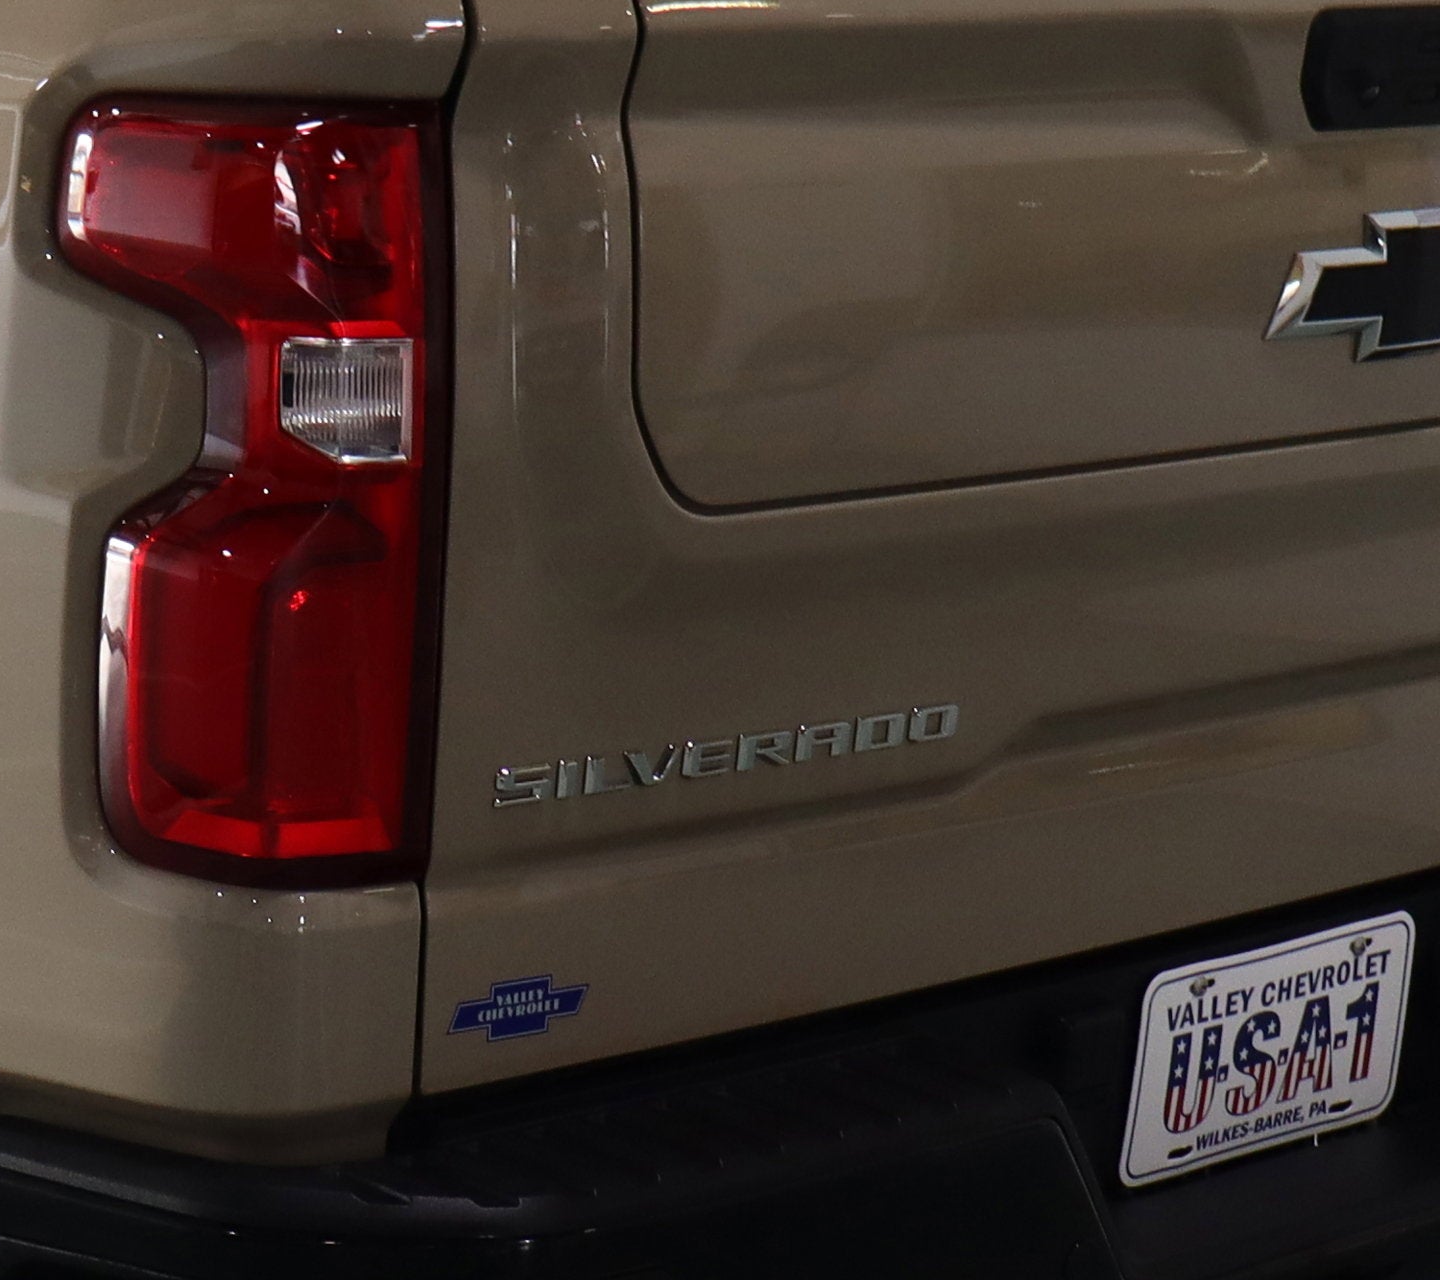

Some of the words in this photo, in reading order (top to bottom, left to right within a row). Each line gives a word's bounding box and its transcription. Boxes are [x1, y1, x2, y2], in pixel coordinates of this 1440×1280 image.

[493, 704, 959, 808] SILVERADO
[478, 999, 560, 1022] CHEVROLET
[497, 989, 544, 1006] VALLEY
[1167, 987, 1255, 1031] VALLEY
[1261, 950, 1392, 1008] CHEVROLET
[1196, 1106, 1304, 1151] WILKES-BARRE,
[1308, 1099, 1327, 1118] PA
